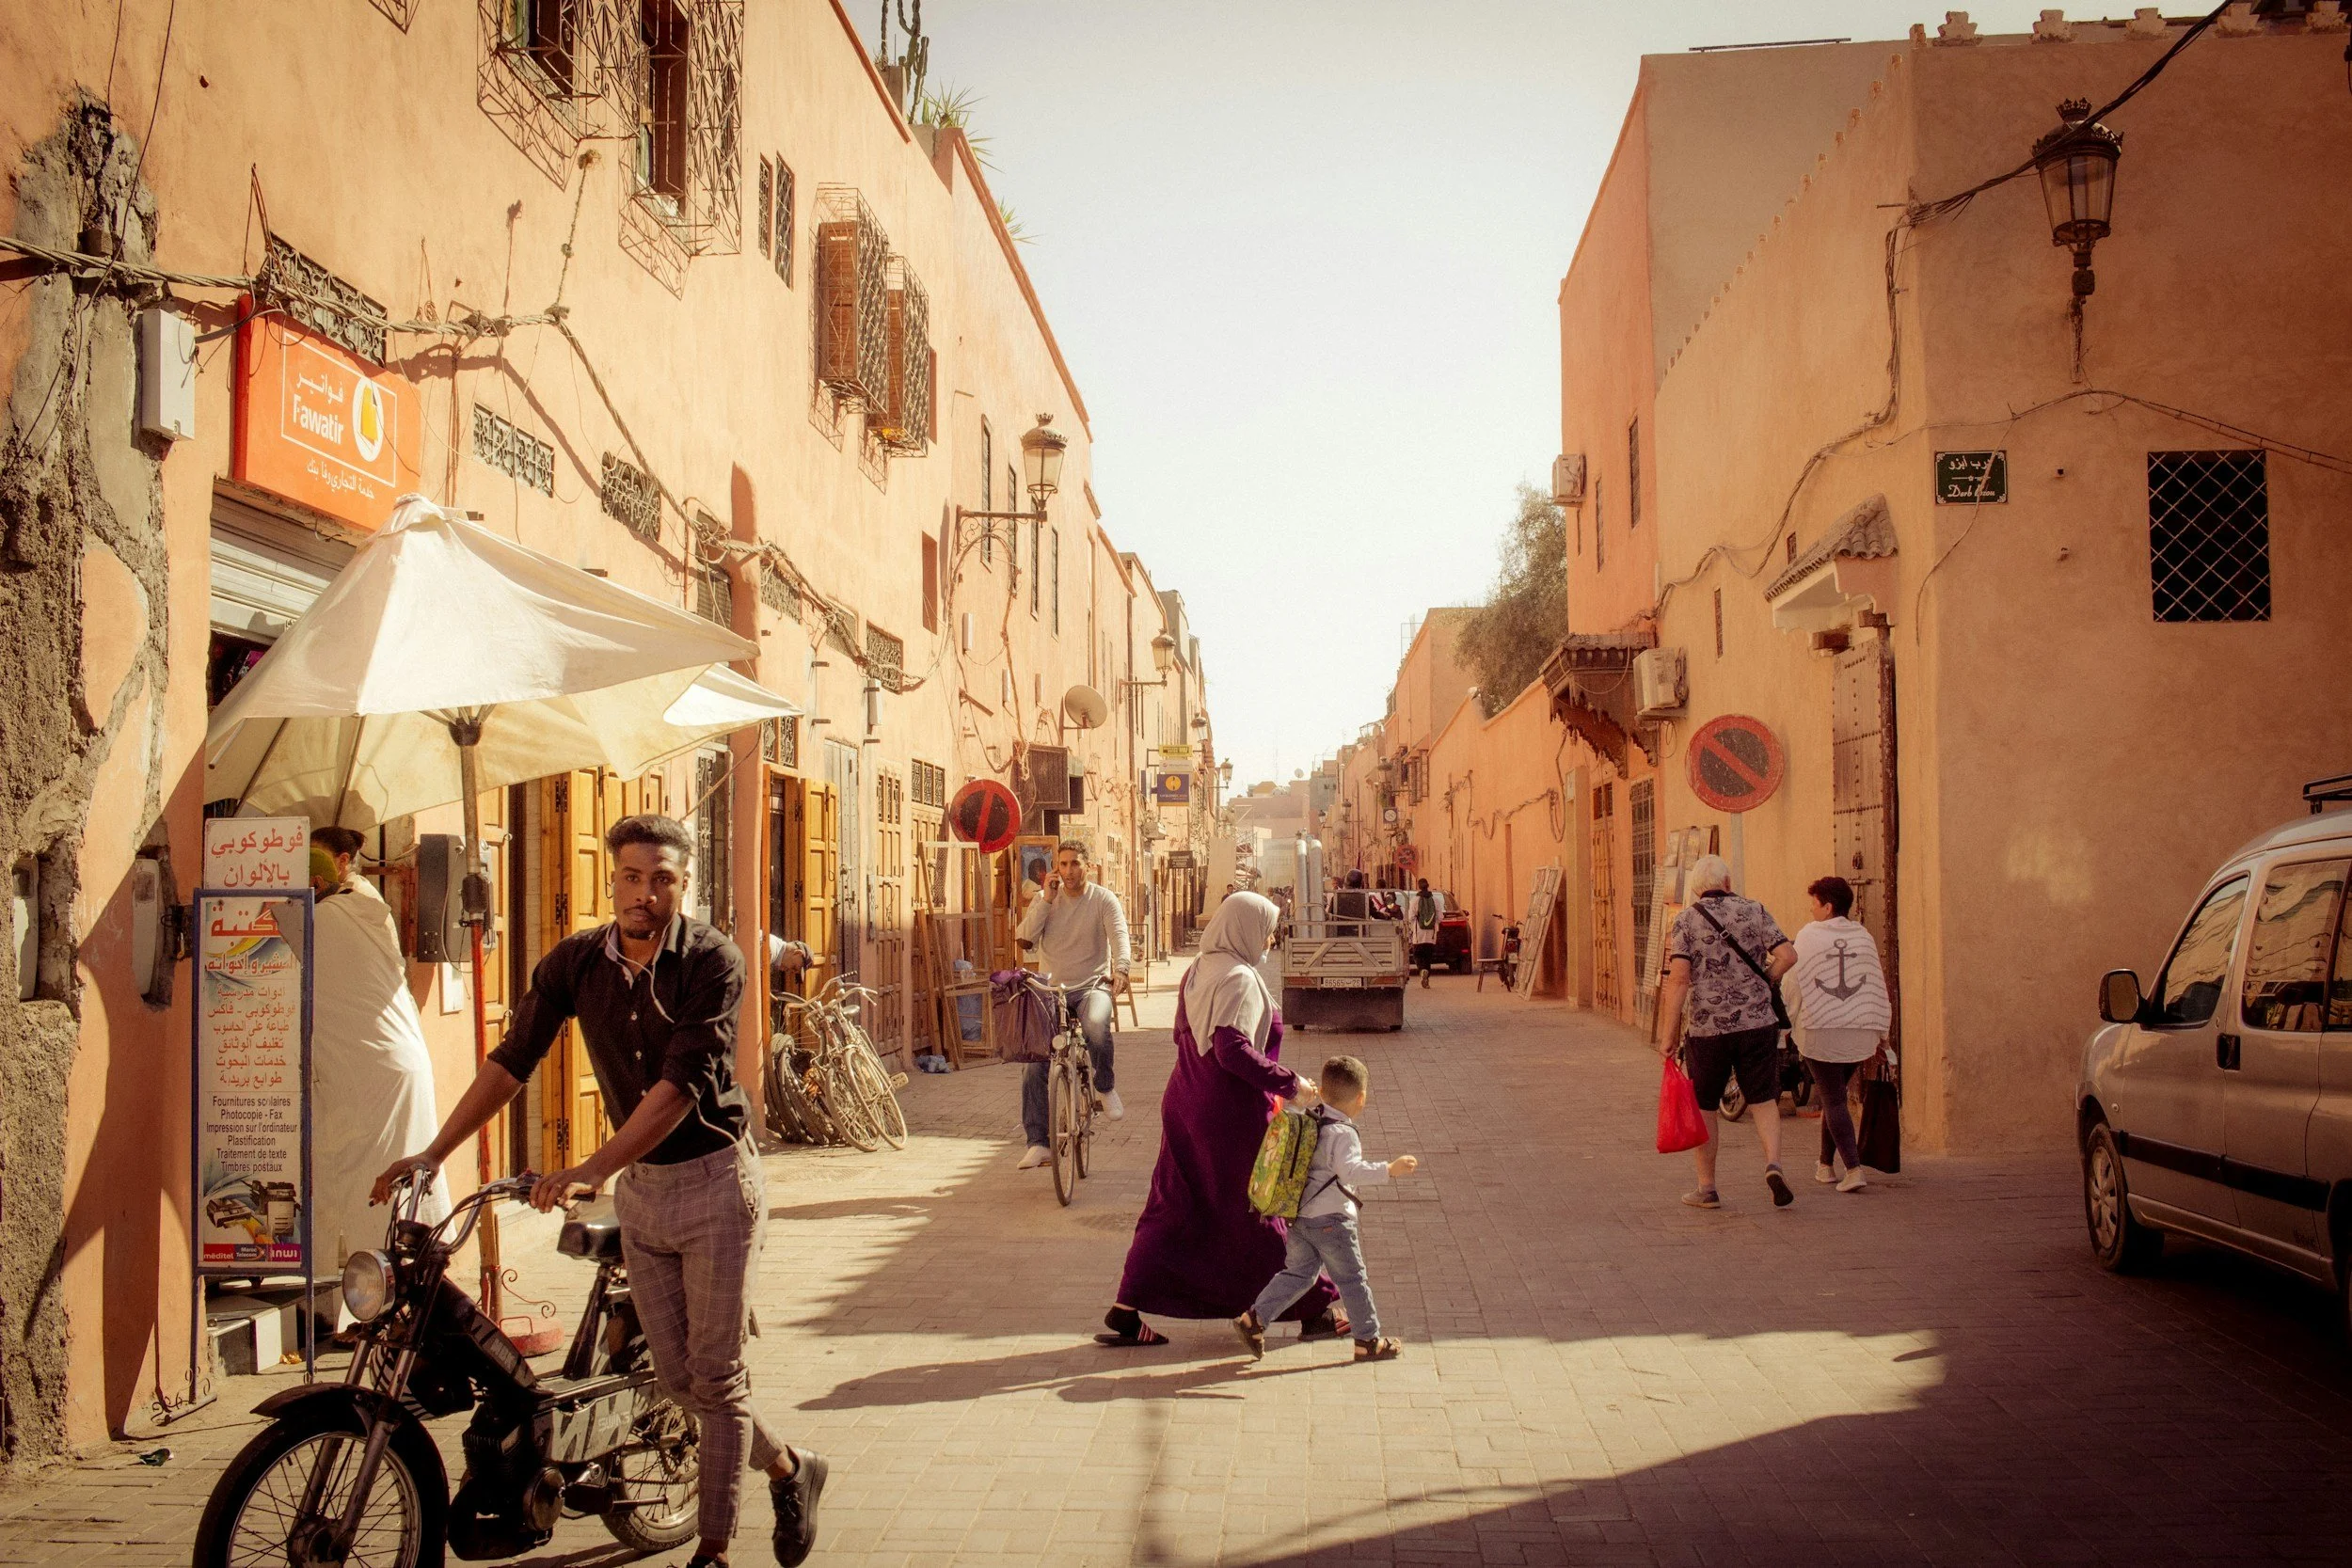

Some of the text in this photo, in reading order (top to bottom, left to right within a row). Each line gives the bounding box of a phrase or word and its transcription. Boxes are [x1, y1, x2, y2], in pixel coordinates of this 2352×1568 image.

[296, 372, 344, 404] فواتير
[293, 393, 344, 445] Fawatir
[1969, 458, 1990, 470] رب
[358, 477, 375, 499] خدمة
[211, 825, 304, 859] فوطوكوبي
[224, 859, 290, 888] بالألوان
[211, 900, 282, 946] كتبة
[207, 1001, 234, 1018] فاكس
[213, 1019, 246, 1035] الحاسوب
[266, 1018, 290, 1035] طباعة
[256, 1037, 284, 1052] تغليف
[254, 1054, 287, 1067] خدمات
[253, 1071, 283, 1089] طوابع
[213, 1095, 292, 1107] Fournitures scolaires
[220, 1108, 263, 1122] Photocopie
[269, 1108, 283, 1120] Fax
[206, 1121, 245, 1135] Impression
[246, 1124, 257, 1133] sur
[227, 1134, 277, 1147] Plastification
[216, 1148, 287, 1159] Traitement de texte
[220, 1160, 283, 1175] Timbres postaux
